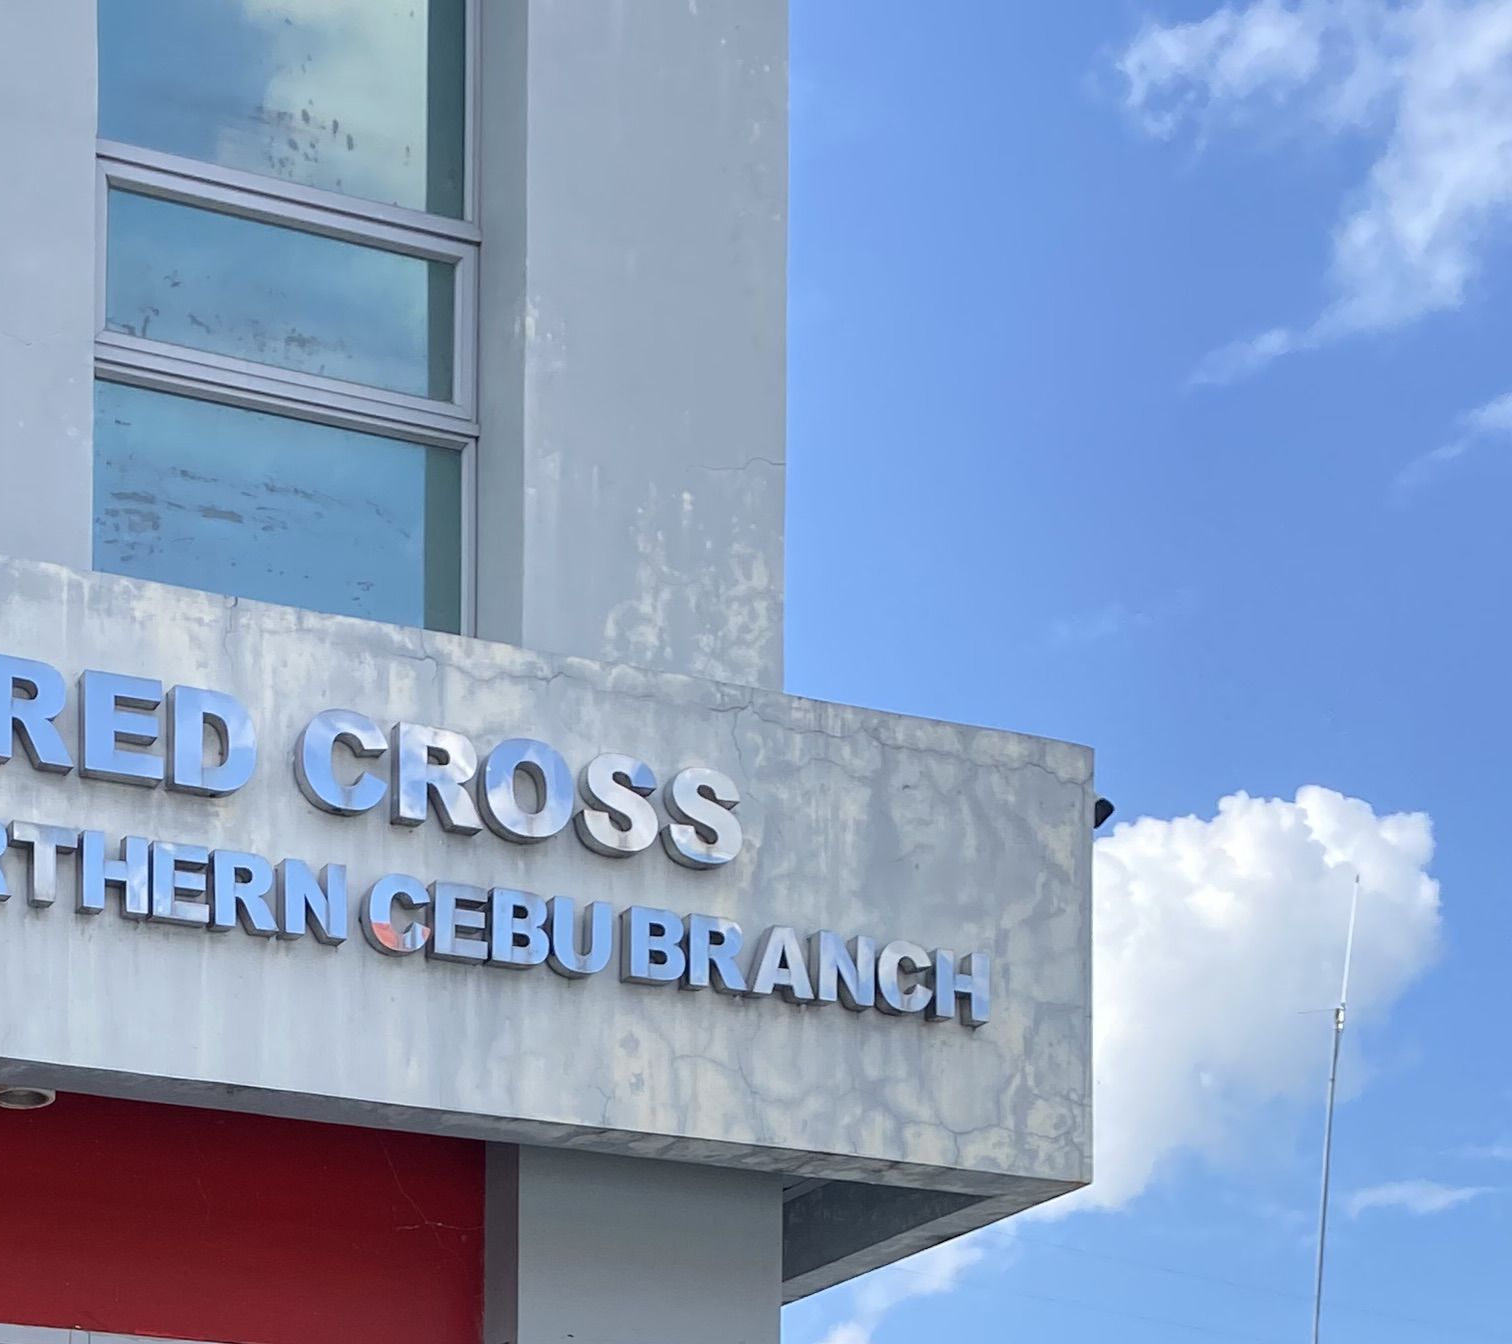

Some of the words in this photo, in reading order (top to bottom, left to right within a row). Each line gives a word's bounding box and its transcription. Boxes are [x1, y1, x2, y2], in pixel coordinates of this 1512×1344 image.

[294, 708, 744, 870] CROSS
[362, 873, 613, 979] CEBU
[621, 905, 991, 1028] BRANCH
